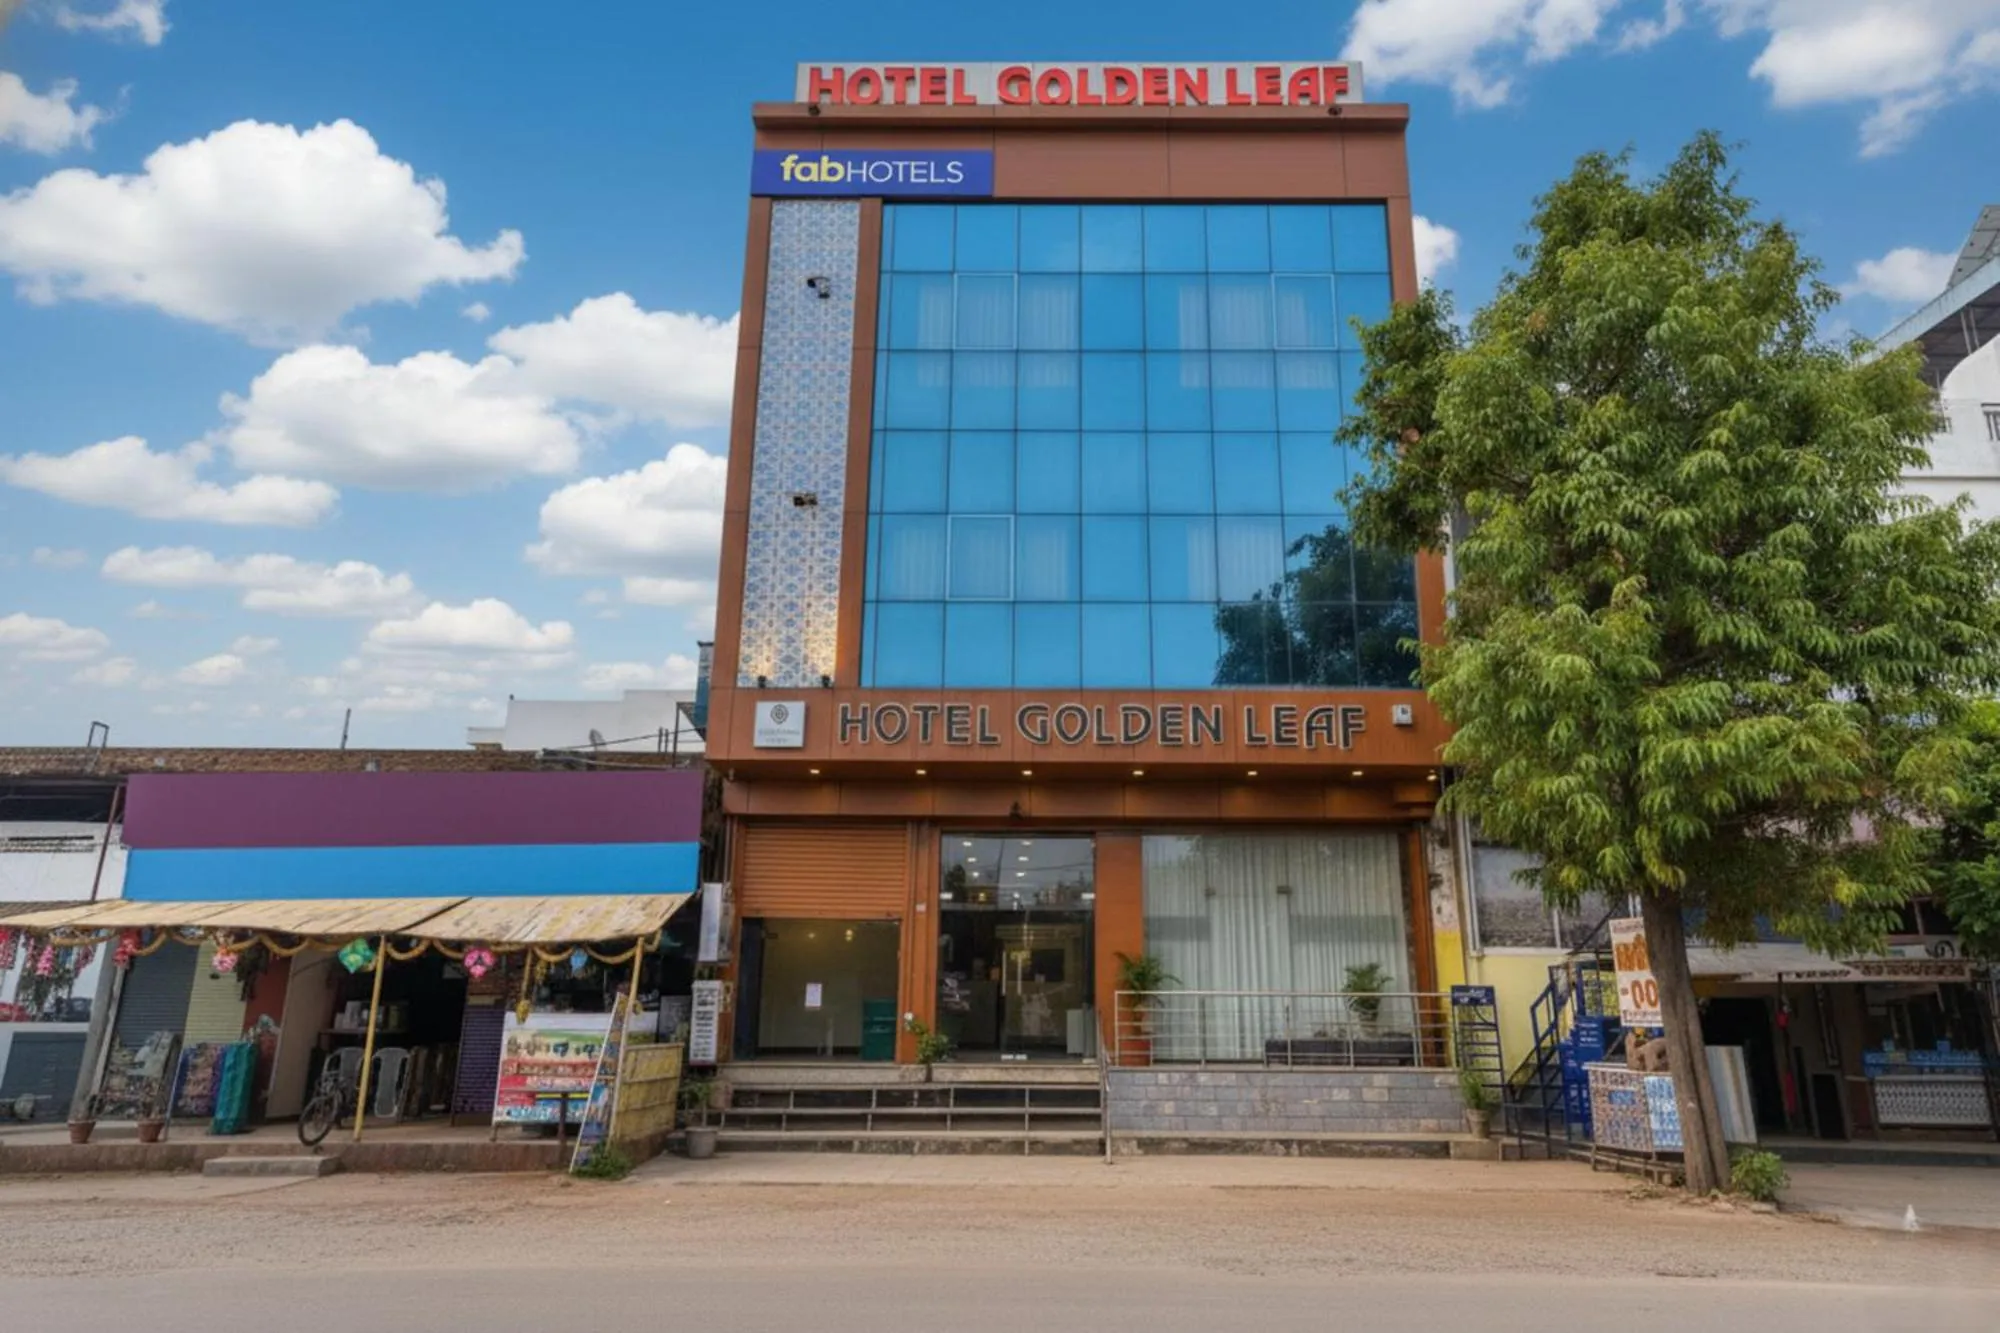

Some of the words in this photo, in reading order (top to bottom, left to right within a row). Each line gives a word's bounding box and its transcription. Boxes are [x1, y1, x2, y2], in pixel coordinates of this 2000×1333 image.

[808, 67, 977, 105] HOTEL
[997, 66, 1209, 105] GOLDEN
[1224, 66, 1349, 105] LEAF
[780, 154, 964, 183] fabHOTELS
[839, 703, 1001, 744] HOTEL
[1016, 703, 1223, 745] GOLDEN
[1244, 704, 1366, 750] LEAF
